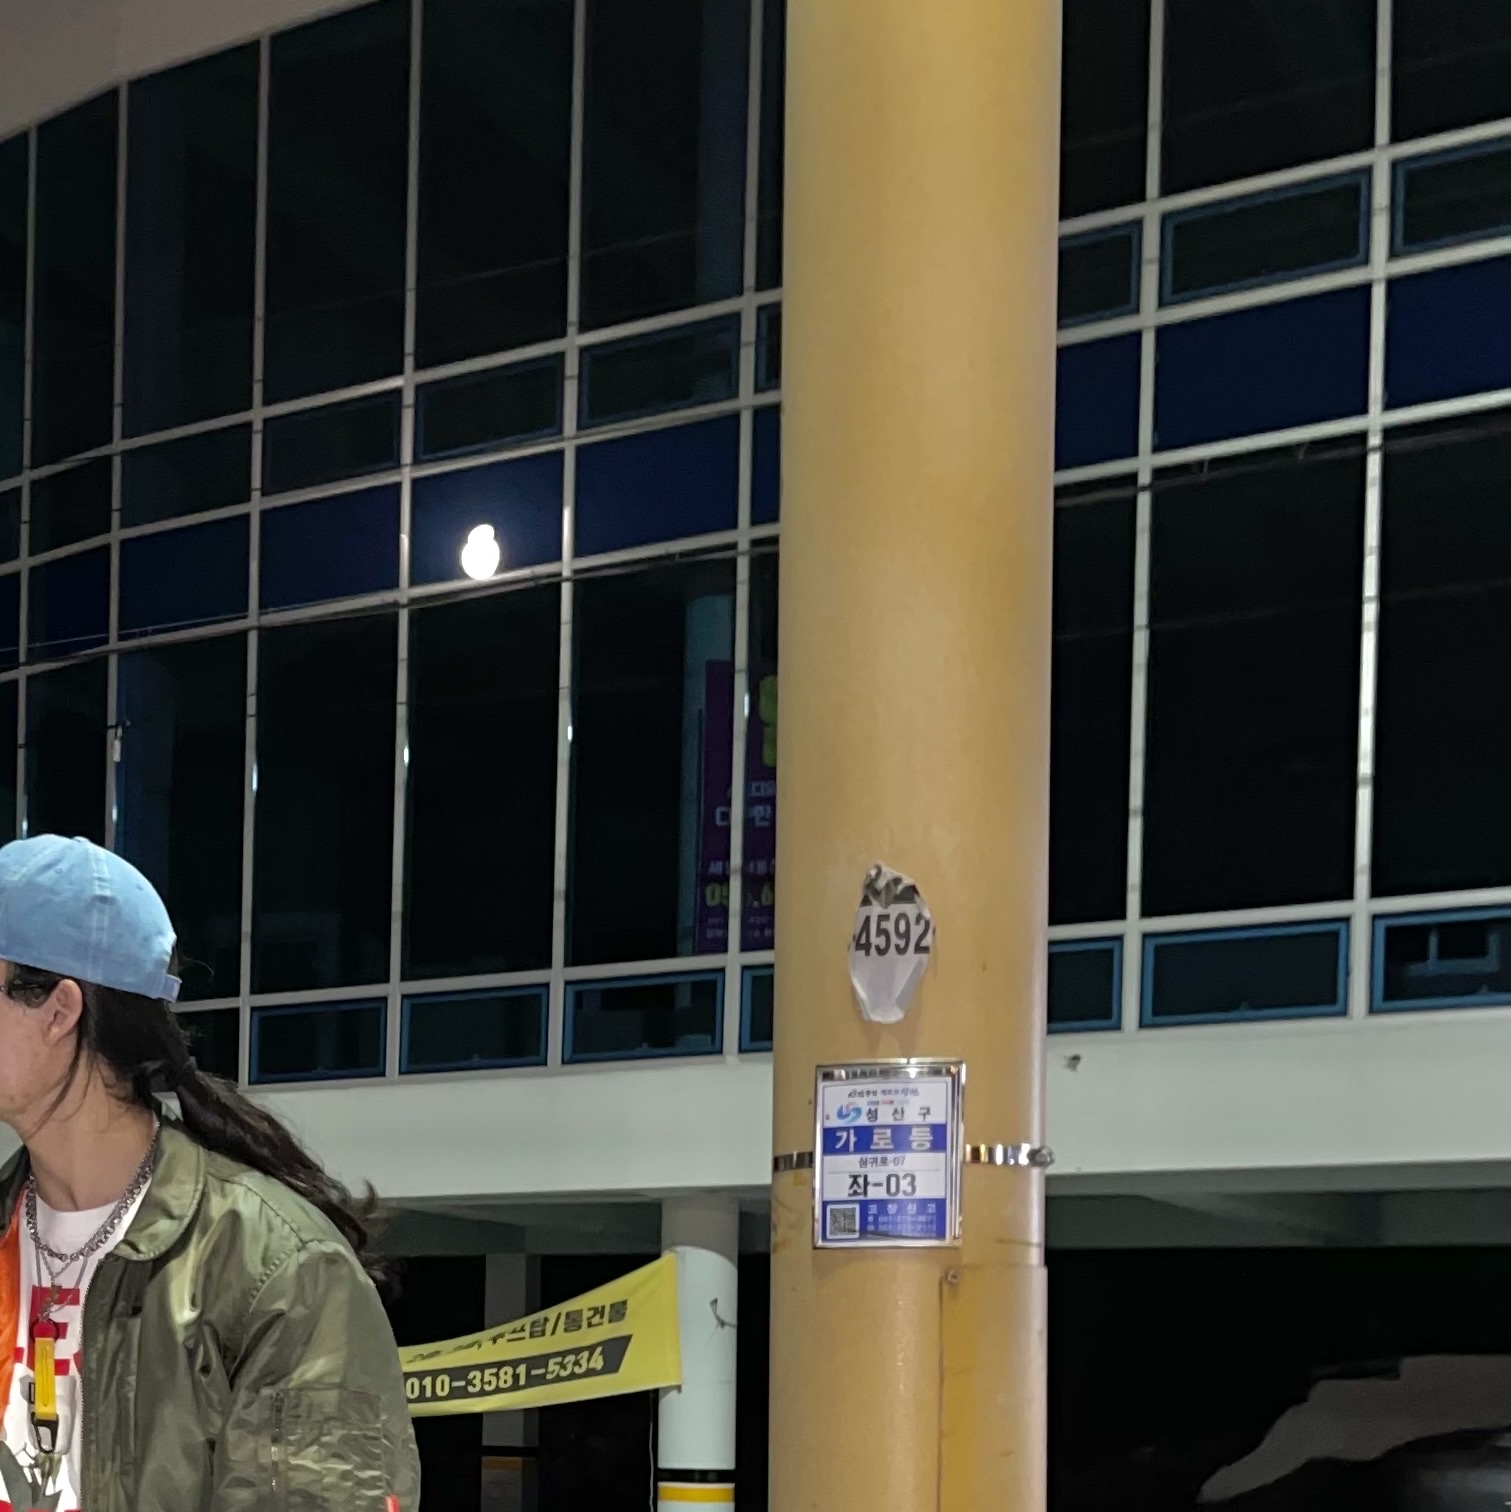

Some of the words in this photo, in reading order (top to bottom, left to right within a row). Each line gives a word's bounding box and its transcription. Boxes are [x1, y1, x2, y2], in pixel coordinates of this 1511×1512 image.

[855, 912, 930, 956] 4592
[834, 1126, 934, 1153] 가로등
[848, 1172, 917, 1197] 좌-03
[405, 1346, 605, 1400] 010-3581-5334
